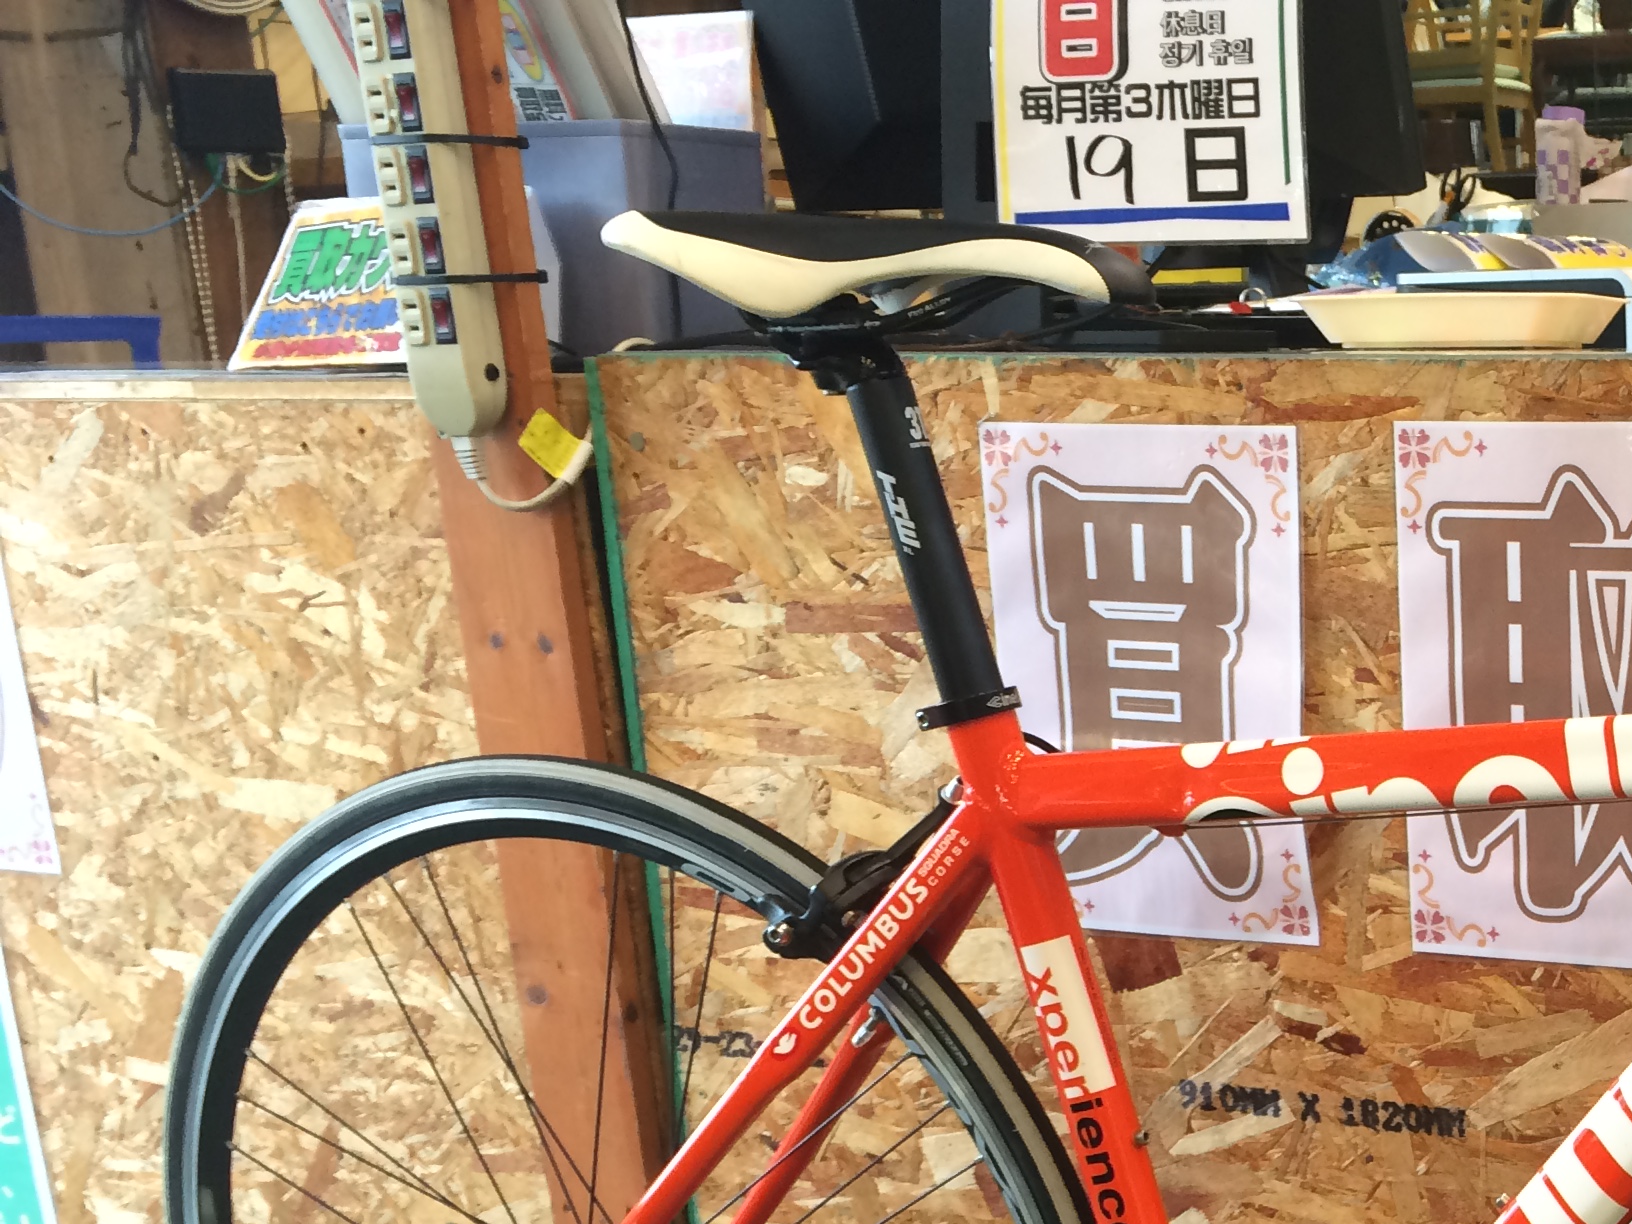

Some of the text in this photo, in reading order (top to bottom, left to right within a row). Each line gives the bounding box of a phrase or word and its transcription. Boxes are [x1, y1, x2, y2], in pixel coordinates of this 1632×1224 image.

[1159, 9, 1226, 37] 休息日
[1158, 37, 1254, 68] 정기 휴일
[1019, 77, 1261, 125] 毎月第3木曜日
[1065, 126, 1249, 206] 19 日
[917, 827, 960, 878] SQUADRA
[928, 837, 971, 887] CORSE
[799, 877, 930, 1030] COLUMBUS
